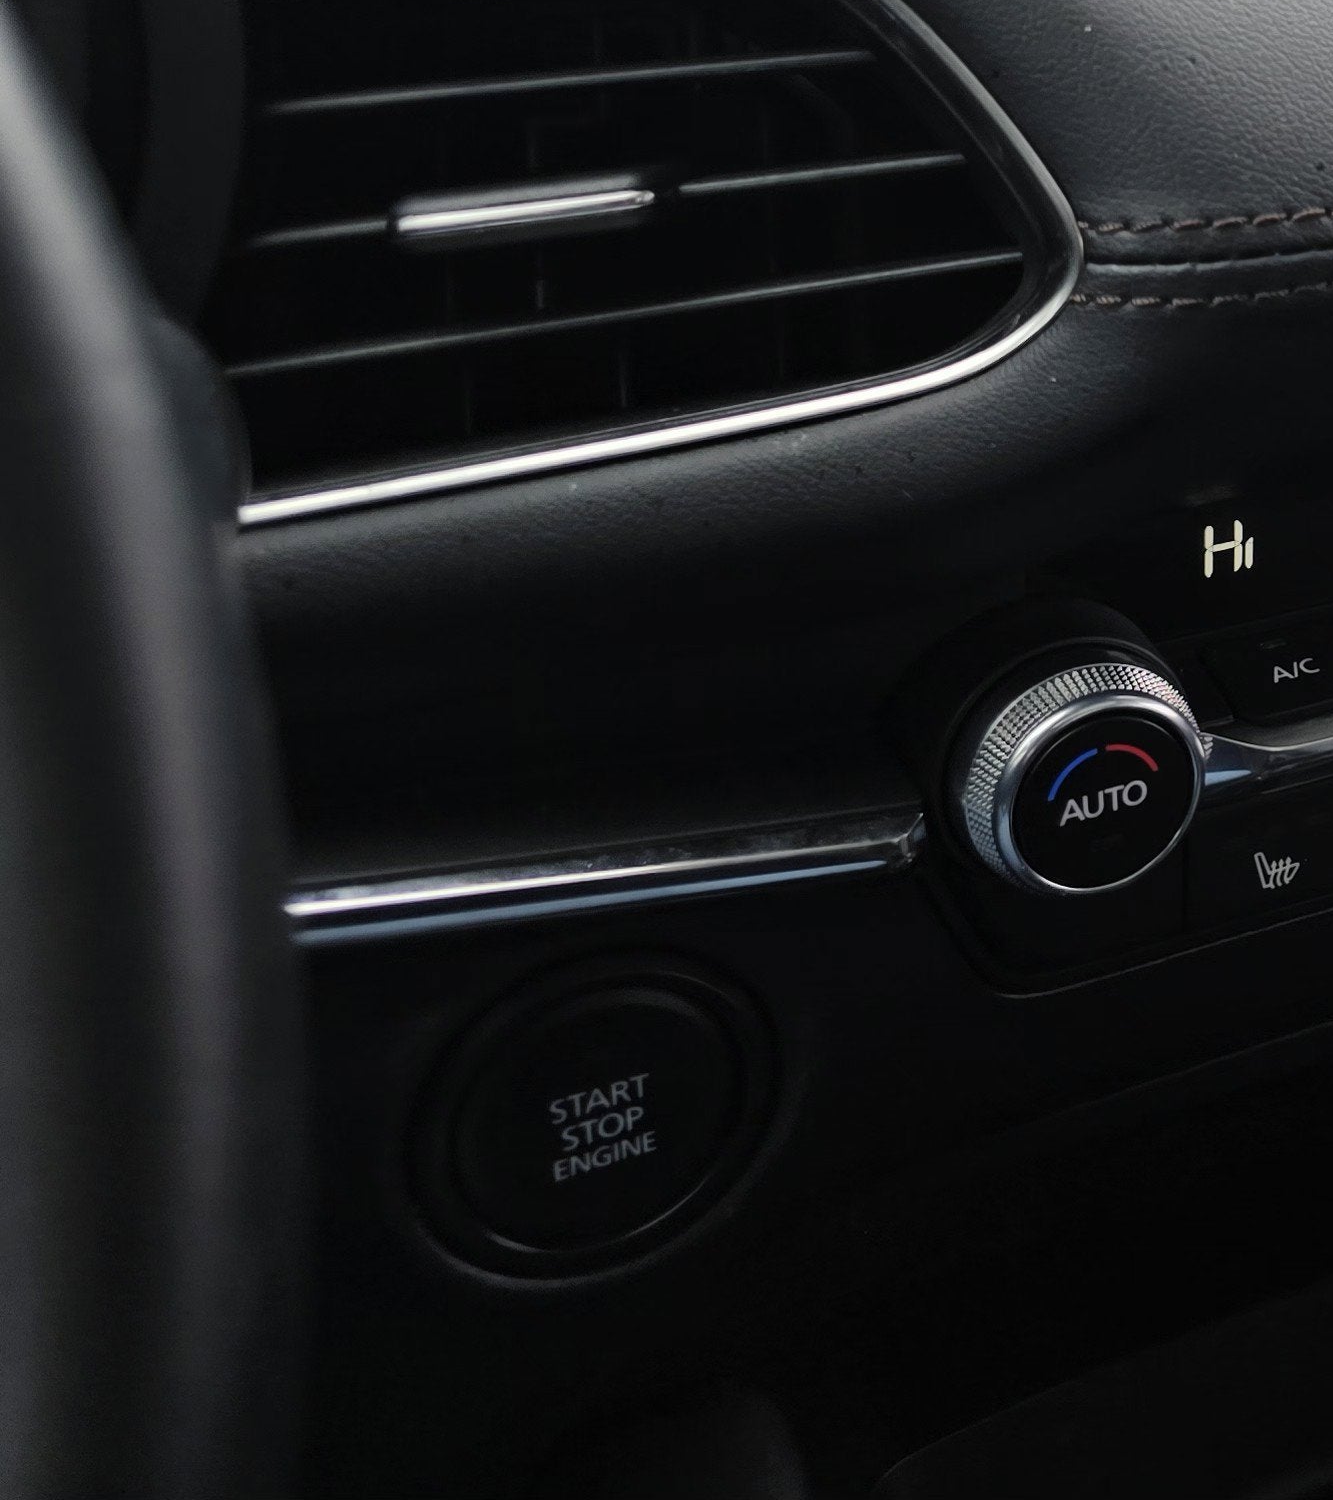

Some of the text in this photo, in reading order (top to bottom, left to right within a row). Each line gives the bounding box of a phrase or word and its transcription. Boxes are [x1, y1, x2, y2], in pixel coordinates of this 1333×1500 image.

[1272, 656, 1321, 684] A/C
[1058, 779, 1149, 827] AUTO
[549, 1072, 650, 1125] START
[560, 1105, 645, 1151] STOP
[553, 1130, 657, 1182] ENGINE
